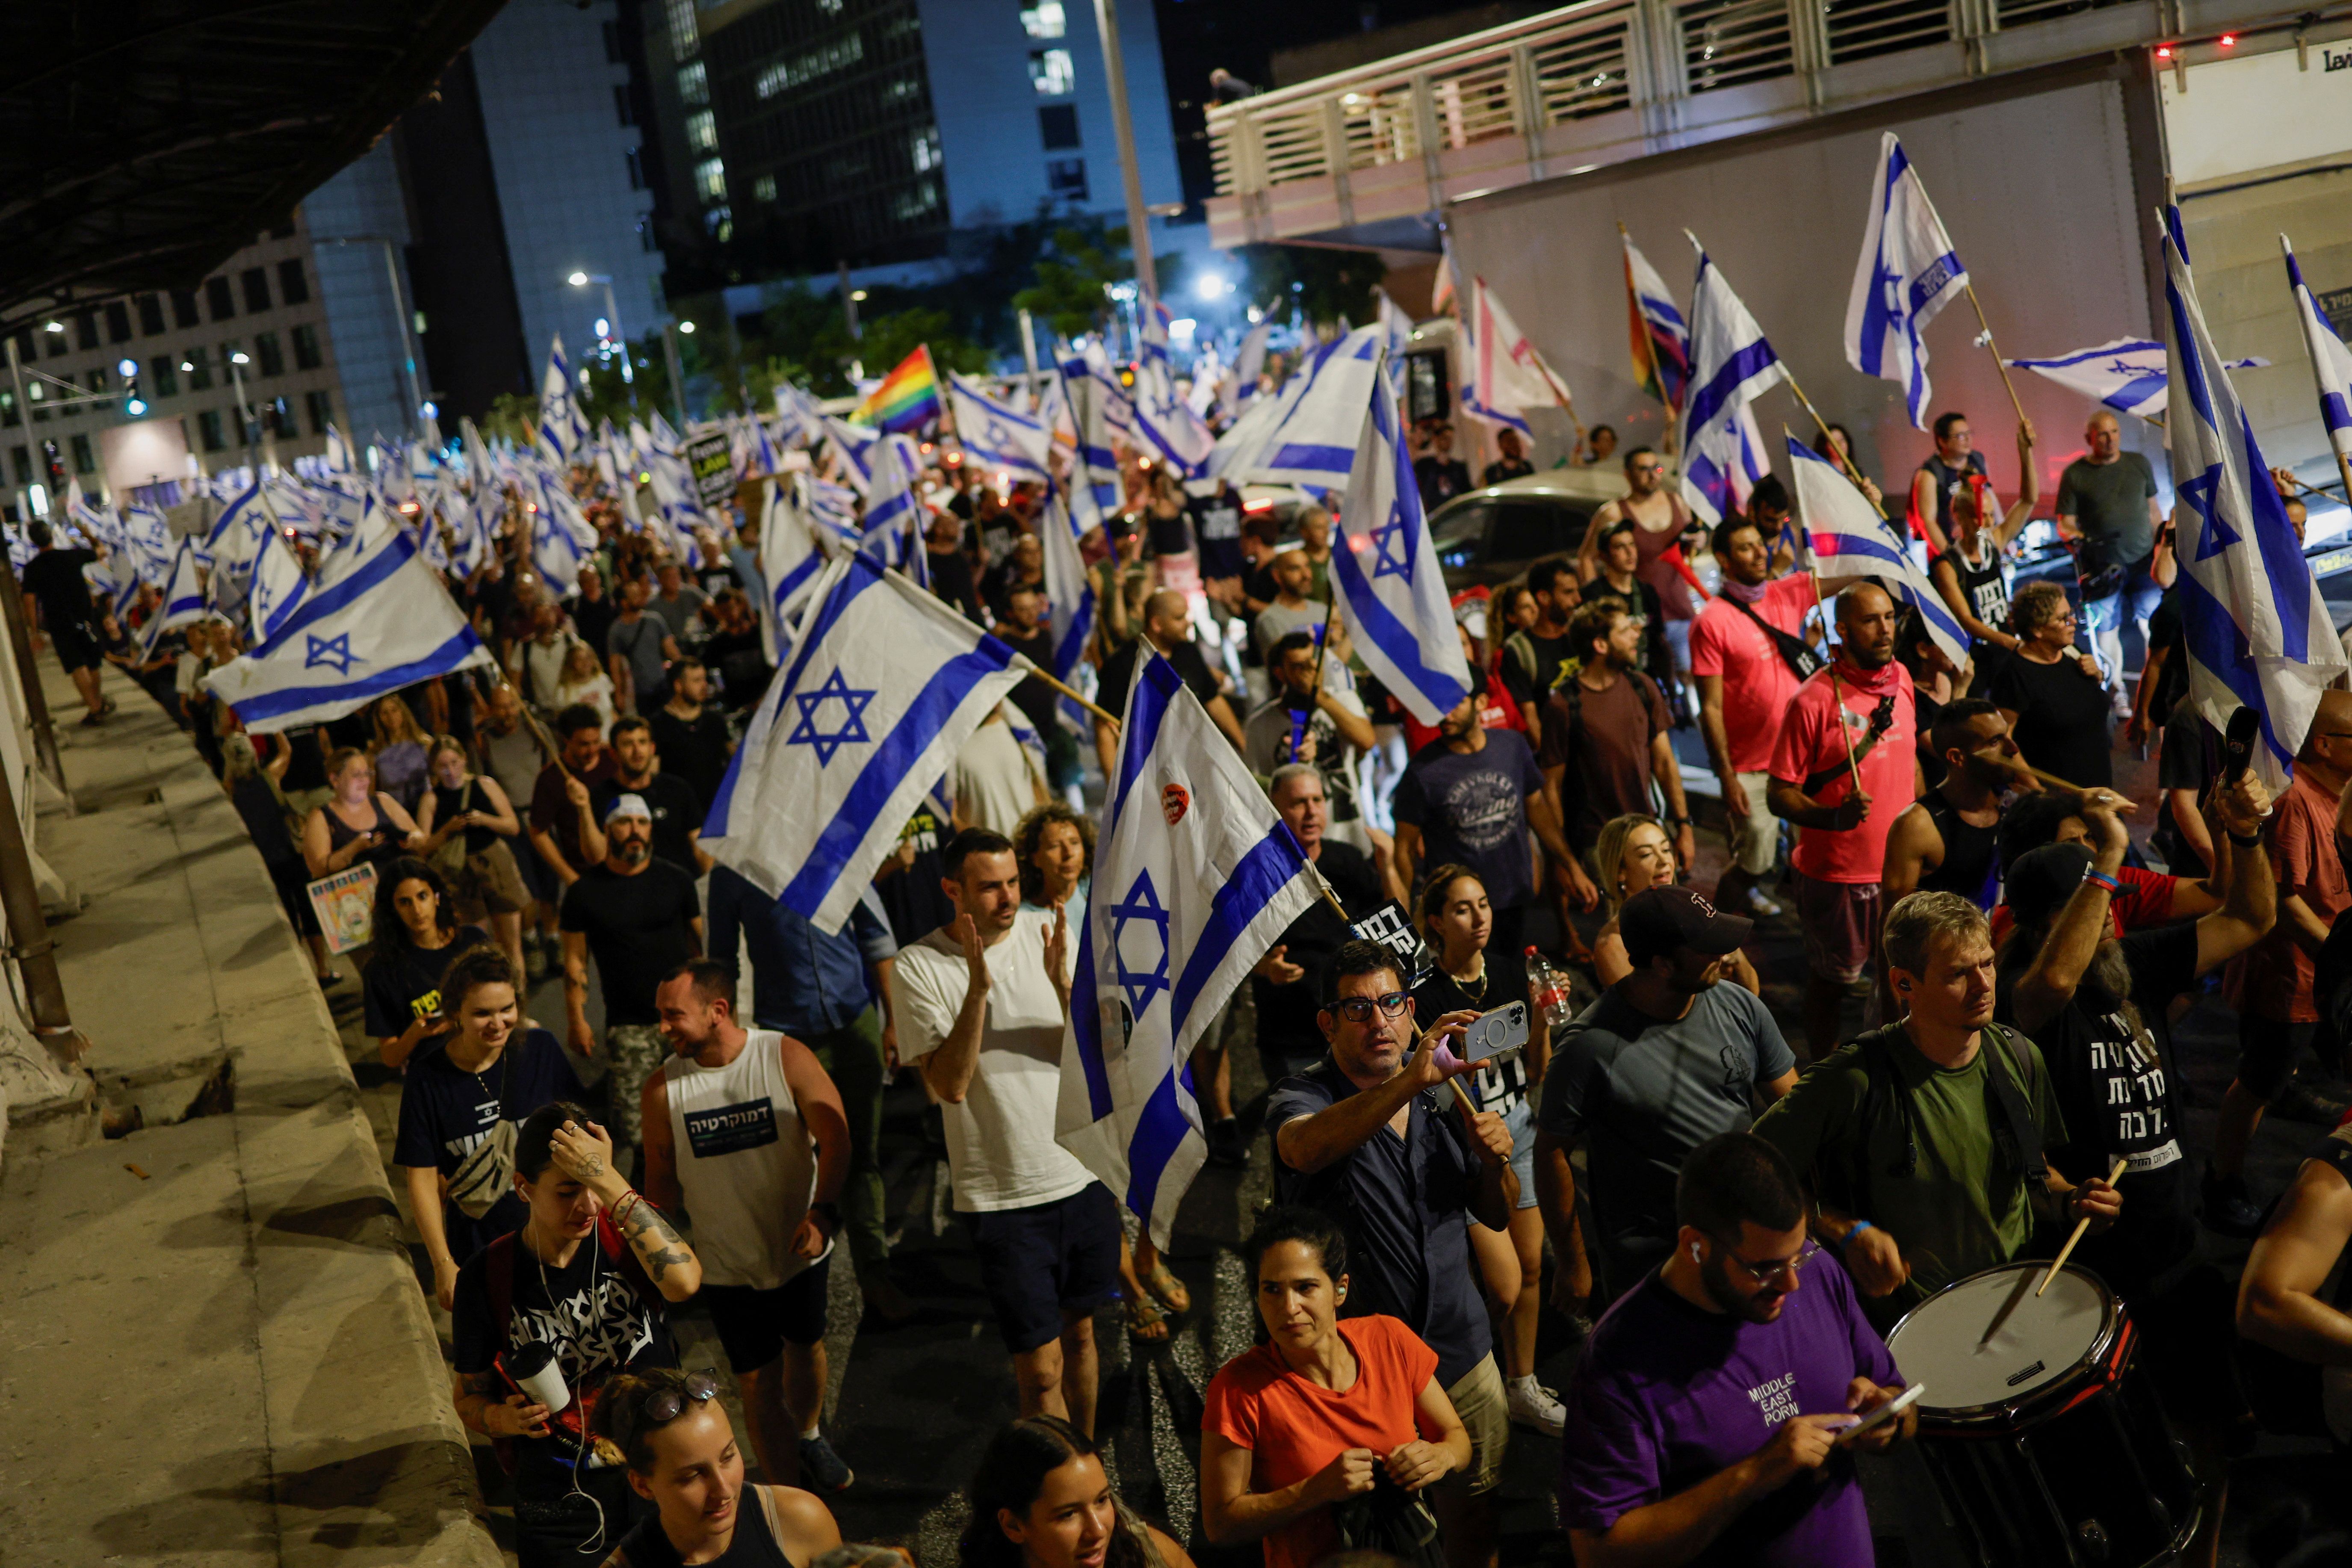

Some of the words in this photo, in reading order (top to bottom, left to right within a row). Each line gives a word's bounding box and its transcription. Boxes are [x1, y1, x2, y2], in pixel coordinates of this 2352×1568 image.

[2108, 1069, 2165, 1100] מדינת
[690, 1106, 768, 1134] דמוקרטיה
[1747, 1372, 1796, 1403] MIDDLE
[1761, 1388, 1792, 1412] EAST
[1764, 1401, 1799, 1427] PORN
